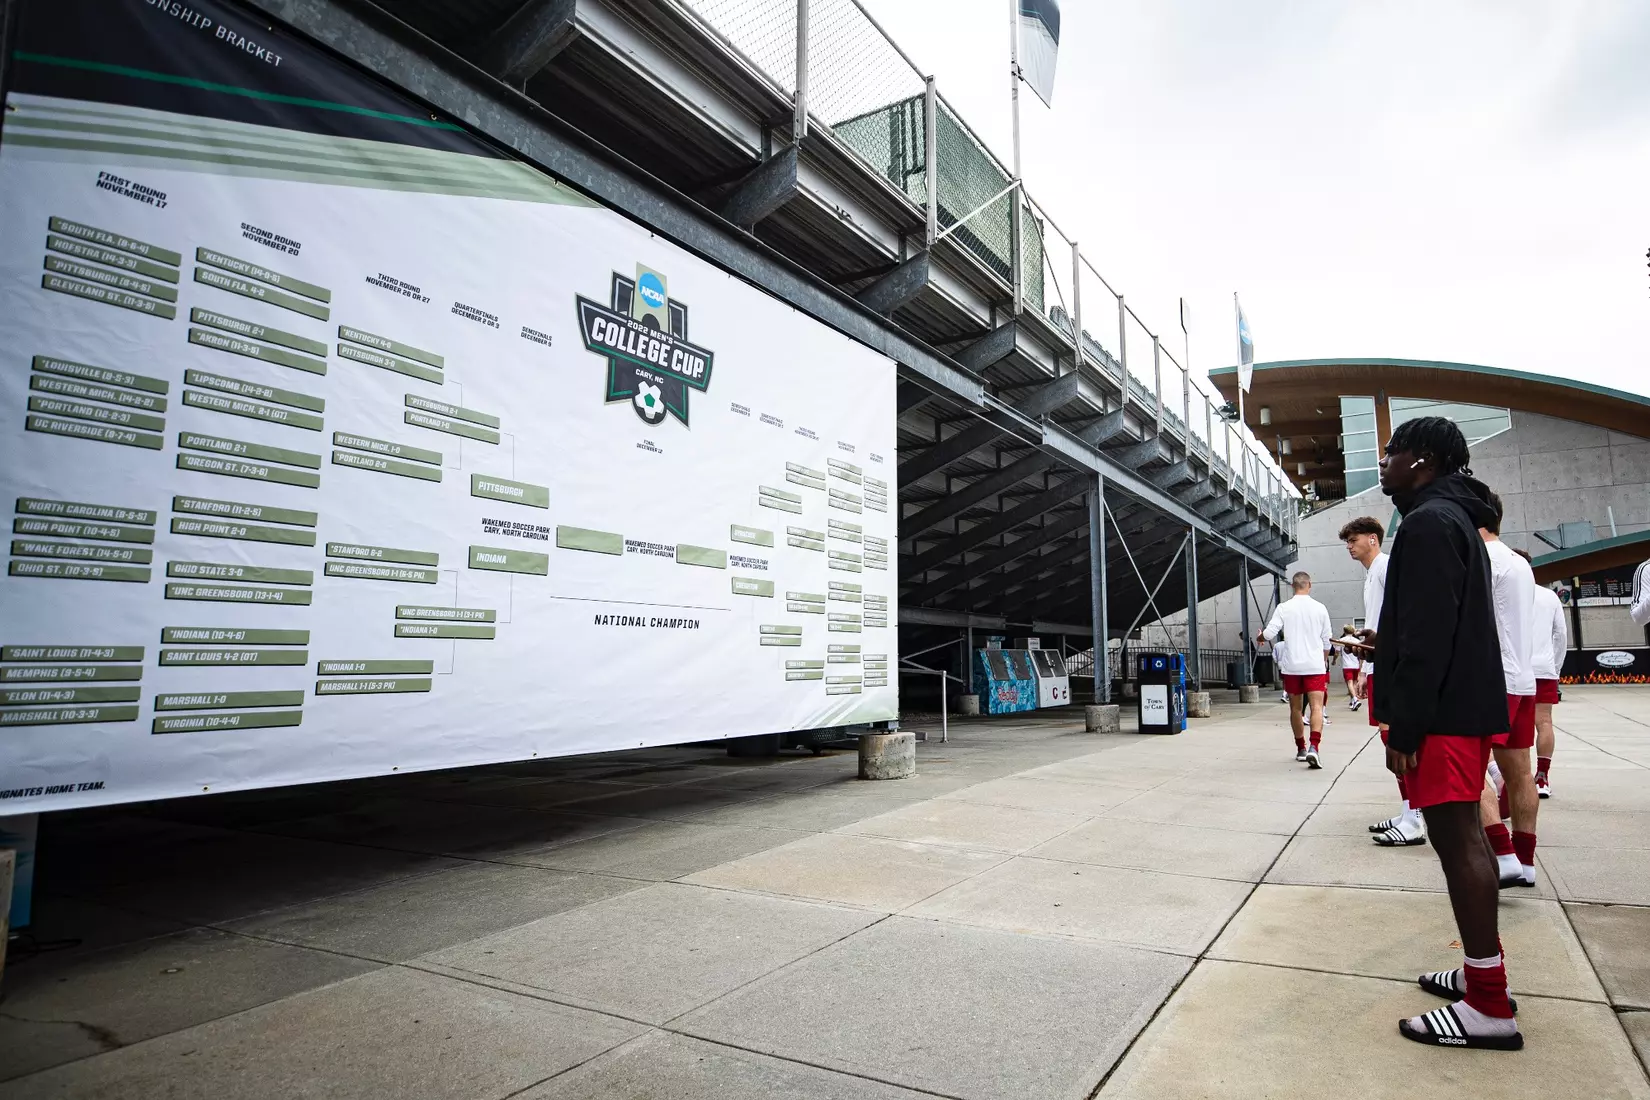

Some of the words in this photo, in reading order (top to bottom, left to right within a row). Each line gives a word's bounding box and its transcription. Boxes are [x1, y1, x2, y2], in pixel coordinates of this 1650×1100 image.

[216, 25, 282, 66] BRACKET
[98, 171, 131, 187] FIRST
[132, 183, 167, 200] ROUND
[96, 180, 154, 205] NOVEMBER
[156, 200, 167, 209] 17
[96, 232, 115, 244] FLA.
[241, 222, 272, 240] SECOND
[274, 234, 301, 249] ROUND
[54, 240, 100, 257] HOFSTRA
[242, 231, 287, 252] NOVEMBER
[288, 247, 299, 256] 20
[50, 278, 104, 297] CLEVELAND
[107, 291, 121, 302] ST.
[202, 272, 230, 287] SOUTH
[232, 280, 248, 291] FLA.
[251, 287, 265, 296] 4-2
[366, 276, 401, 294] NOVEMBER
[378, 273, 398, 285] THIRD
[399, 281, 420, 293] ROUND
[641, 286, 664, 303] NCAA
[451, 307, 482, 322] DECEMBER
[454, 302, 498, 322] QUARTERFINALS
[198, 312, 250, 332] PITTSBURGH
[252, 327, 264, 335] 2-1
[521, 332, 547, 345] DECEMBER
[522, 326, 552, 341] SEMIFINALS
[628, 320, 648, 334] 2022
[650, 330, 673, 344] MEN'S
[592, 317, 670, 367] COLLEGE
[672, 349, 704, 378] CUP
[342, 347, 384, 364] PITTSBURGH
[636, 369, 653, 381] CARY,
[38, 379, 87, 394] WESTERN
[89, 388, 116, 400] MICH.
[188, 393, 230, 408] WESTERN
[232, 402, 256, 413] MICH.
[258, 408, 270, 416] 2-1
[272, 409, 287, 420] (OT)
[34, 419, 48, 428] UC
[50, 422, 103, 436] RIVERSIDE
[411, 414, 440, 426] PORTLAND
[187, 436, 232, 450] PORTLAND
[234, 444, 246, 452] 2-1
[337, 435, 370, 447] WESTERN
[225, 462, 238, 472] ST.
[478, 481, 524, 497] PITTSBURGH
[66, 506, 113, 518] CAROLINA
[22, 522, 49, 531] HIGH
[50, 524, 82, 533] POINT
[179, 521, 201, 530] HIGH
[203, 524, 229, 534] POINT
[231, 527, 246, 536] 2-0
[482, 518, 511, 528] WAKEMED
[512, 522, 534, 531] SOCCER
[484, 526, 500, 535] CARY,
[502, 529, 521, 537] NORTH
[522, 531, 548, 541] CAROLINA
[56, 546, 95, 556] FOREST
[476, 553, 507, 564] INDIANA
[18, 564, 43, 573] OHIO
[46, 566, 62, 574] ST.
[175, 564, 197, 574] OHIO
[199, 566, 226, 575] STATE
[229, 568, 243, 576] 3-0
[345, 566, 389, 576] GREENSBORO
[196, 589, 253, 599] GREENSBORO
[594, 614, 646, 628] NATIONAL
[650, 618, 700, 630] CHAMPION
[47, 649, 78, 657] LOUIS
[166, 653, 194, 661] SAINT
[196, 653, 222, 661] LOUIS
[240, 653, 258, 661] (OT)
[7, 668, 58, 677] MEMPHIS
[383, 682, 396, 690] PK)
[163, 696, 211, 705] MARSHALL
[1, 712, 57, 722] MARSHALL
[45, 784, 74, 794] HOME
[78, 781, 105, 791] TEAM.
